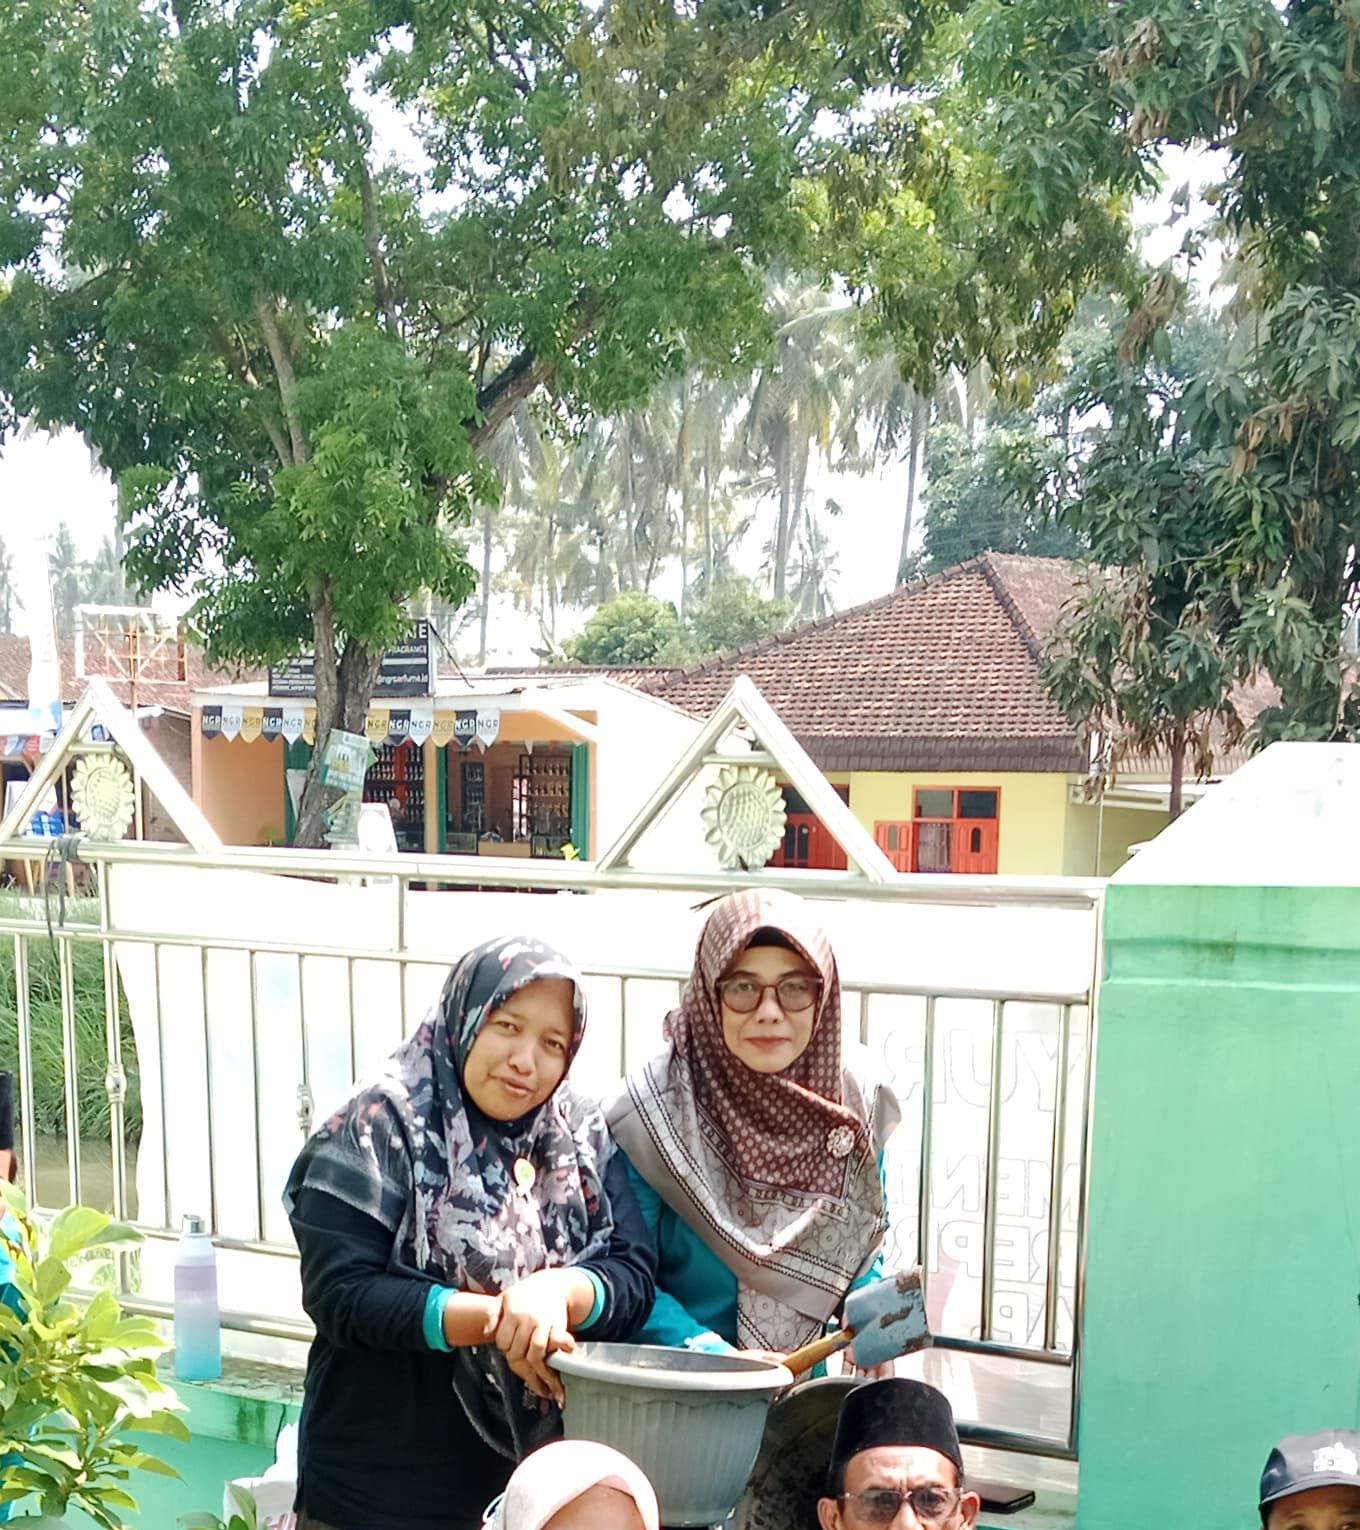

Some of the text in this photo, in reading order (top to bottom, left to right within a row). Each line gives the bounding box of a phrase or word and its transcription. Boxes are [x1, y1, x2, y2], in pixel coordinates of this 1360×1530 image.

[283, 719, 302, 729] NGR
[367, 719, 387, 729] NGR
[389, 719, 409, 730] NGR
[411, 719, 432, 729] NGR
[455, 719, 476, 730] NGR
[478, 719, 498, 729] NGR
